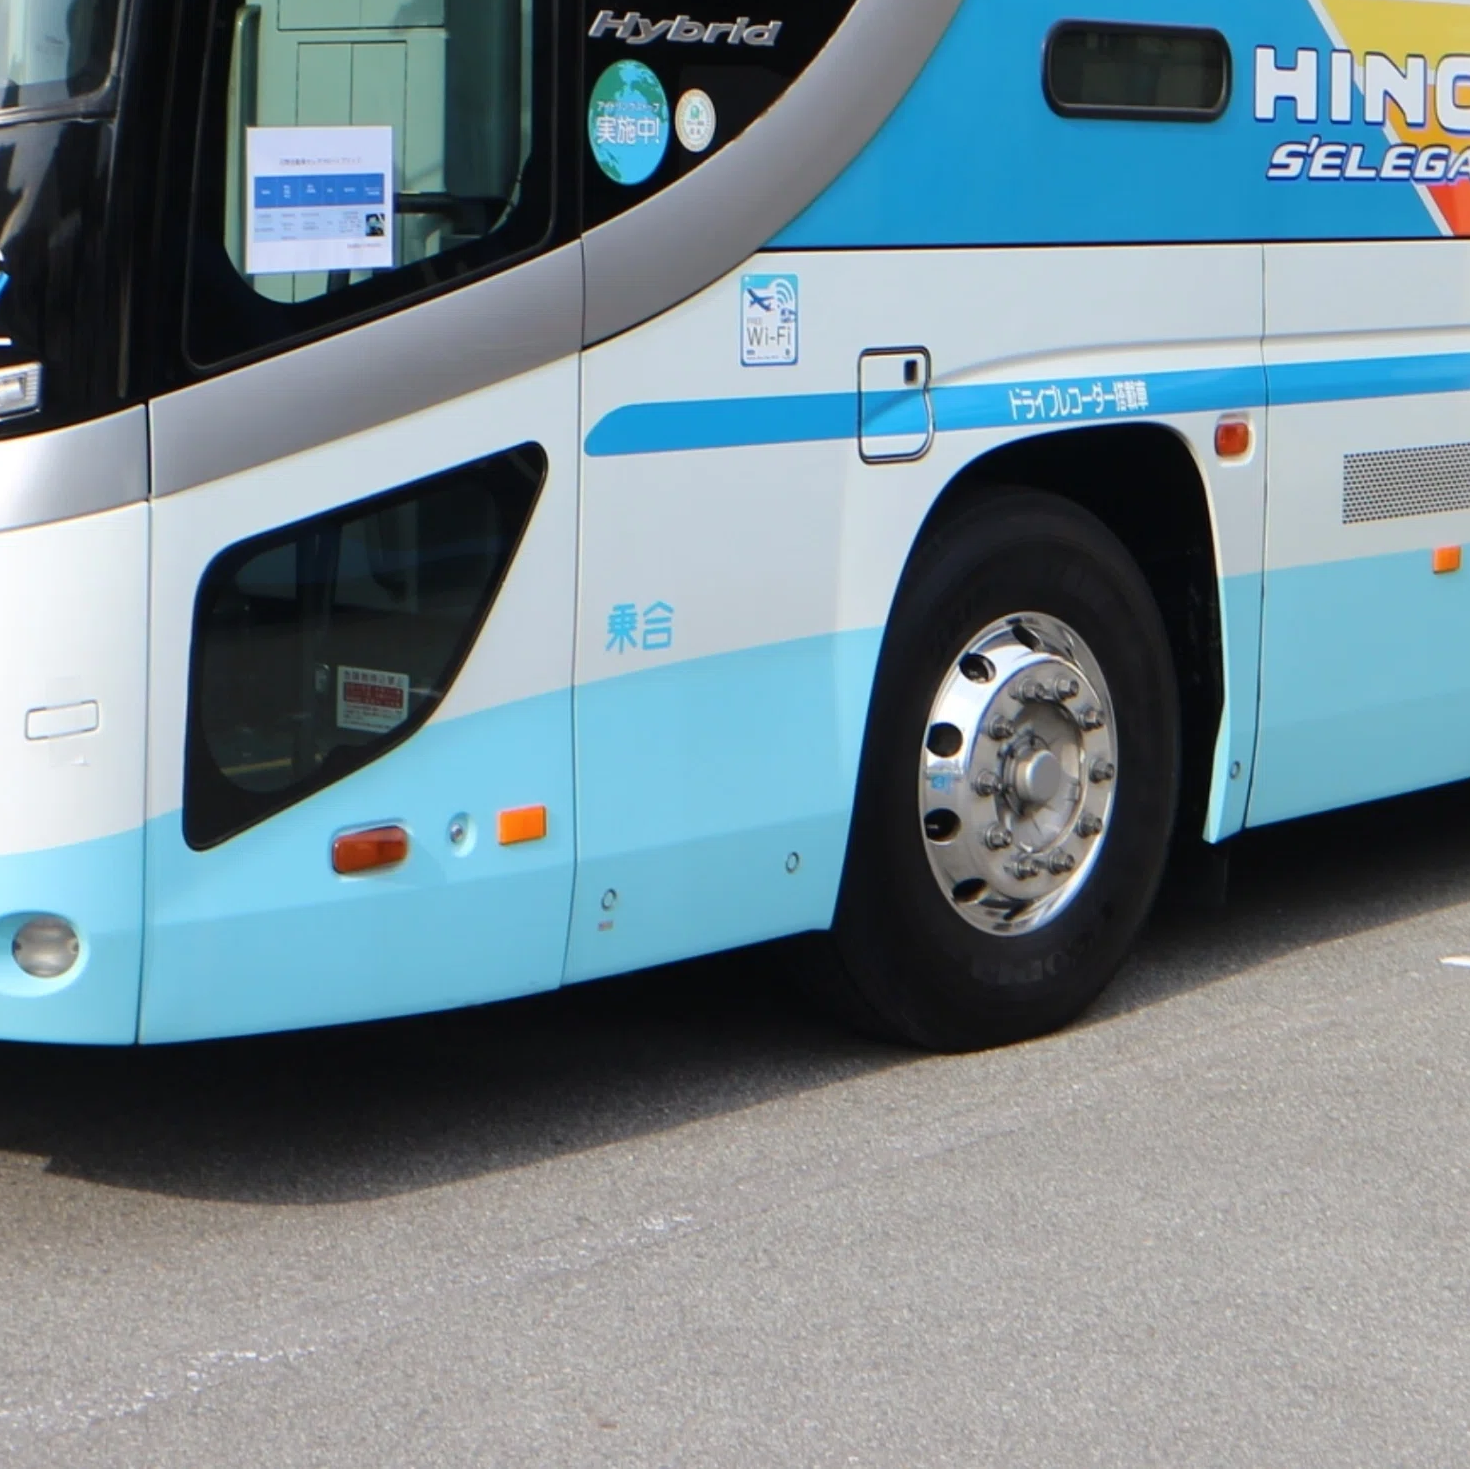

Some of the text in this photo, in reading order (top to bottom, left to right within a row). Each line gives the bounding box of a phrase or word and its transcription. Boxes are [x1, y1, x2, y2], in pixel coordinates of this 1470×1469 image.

[588, 10, 782, 46] Hybrid
[747, 326, 791, 346] Wi-Fi
[1009, 380, 1149, 421] ドライブレコーダー搭載車
[605, 600, 674, 654] 乗合
